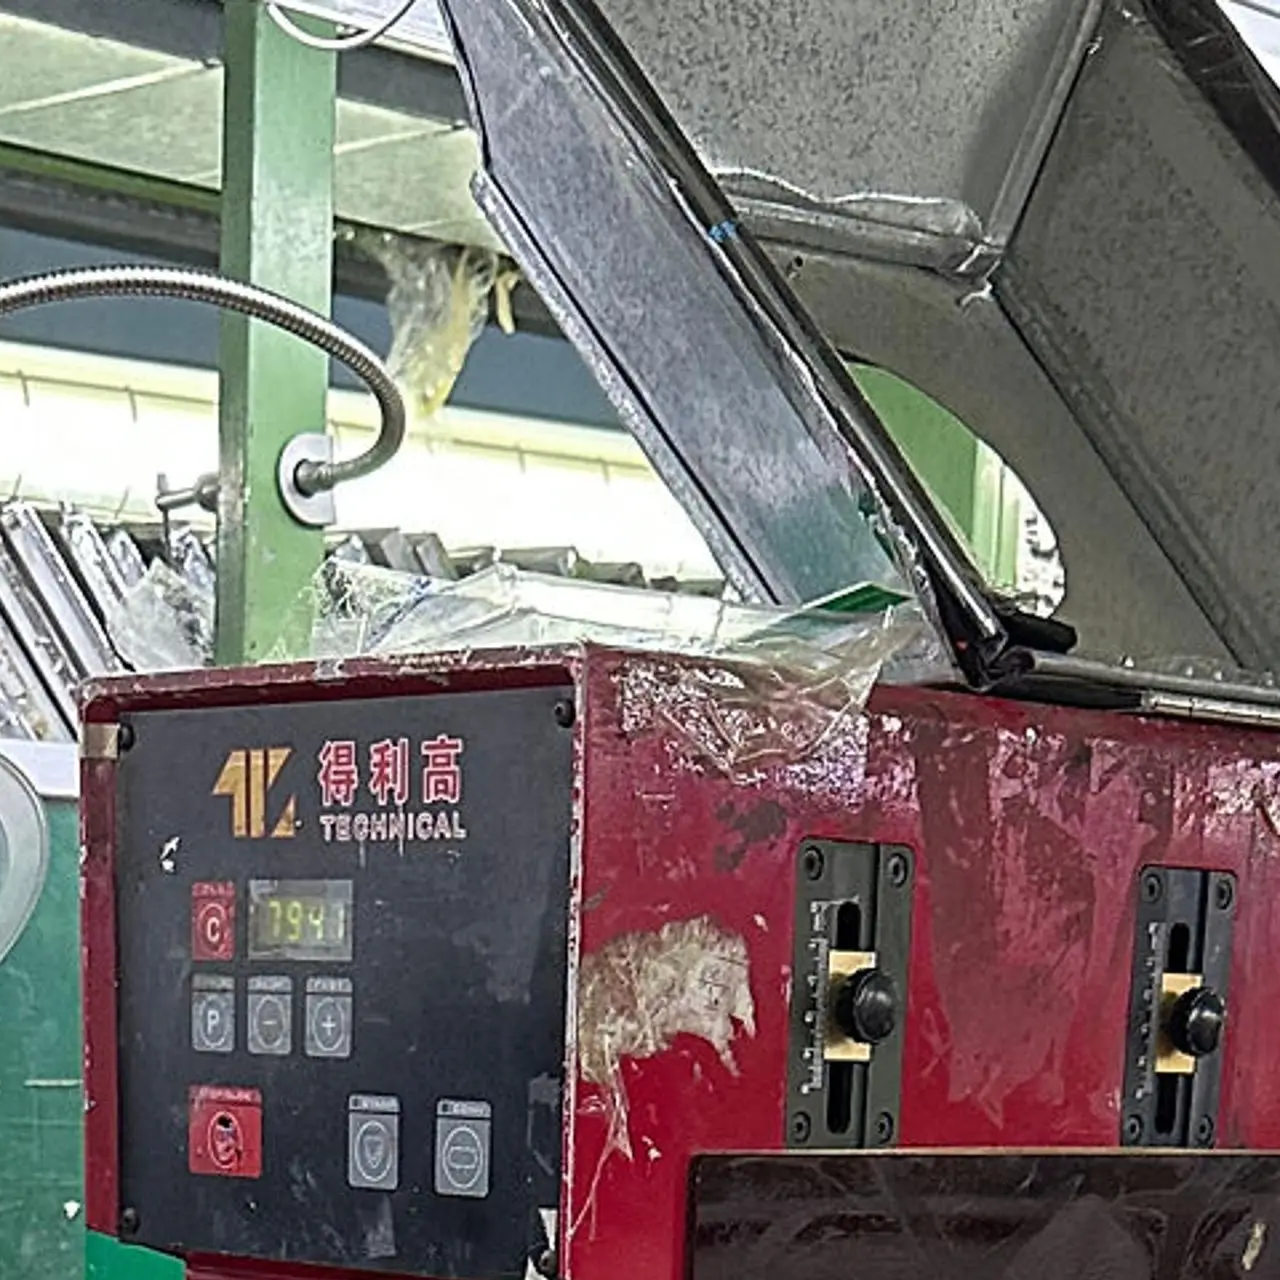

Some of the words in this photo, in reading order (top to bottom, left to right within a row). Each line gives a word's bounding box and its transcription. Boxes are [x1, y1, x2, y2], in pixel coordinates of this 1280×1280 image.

[319, 735, 463, 806] 得利高
[320, 811, 467, 843] TECHNICAL
